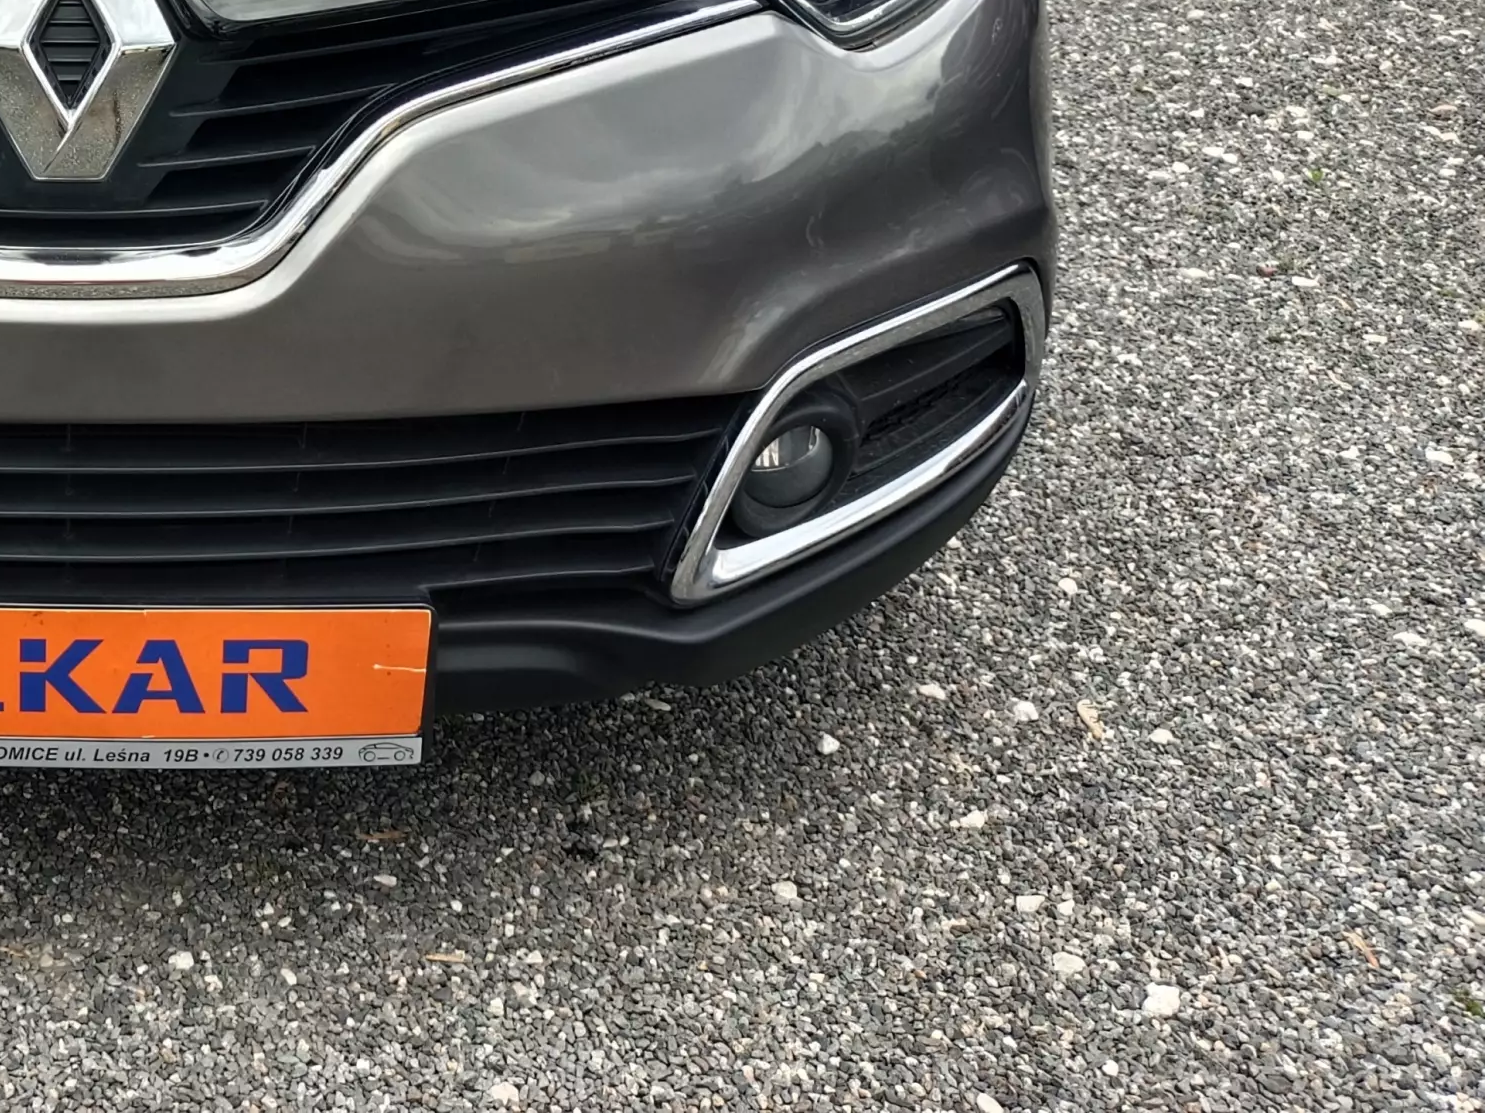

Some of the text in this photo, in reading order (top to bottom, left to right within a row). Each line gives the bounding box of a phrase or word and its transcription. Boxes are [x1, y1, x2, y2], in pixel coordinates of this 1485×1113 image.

[64, 747, 87, 762] ul.
[93, 746, 151, 763] Leśna
[163, 749, 199, 763] 19B
[232, 748, 266, 763] 739
[271, 746, 305, 762] 058
[310, 746, 344, 761] 339
